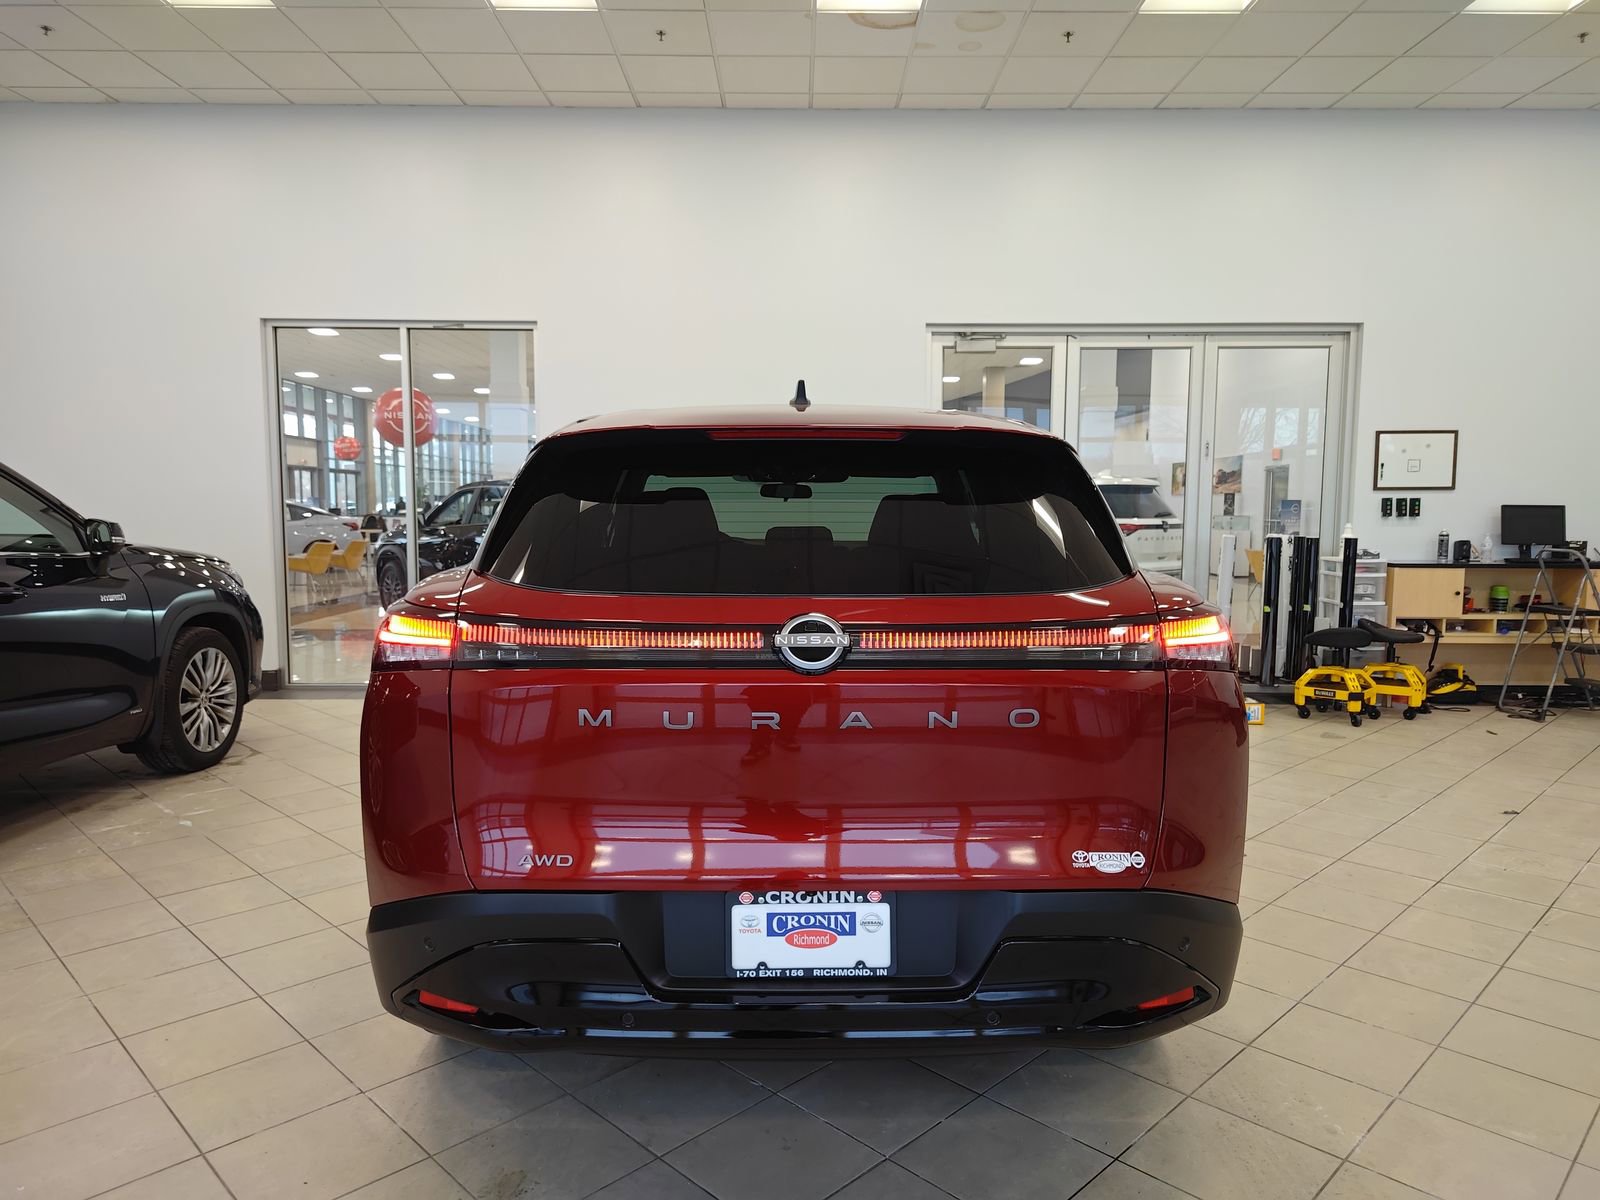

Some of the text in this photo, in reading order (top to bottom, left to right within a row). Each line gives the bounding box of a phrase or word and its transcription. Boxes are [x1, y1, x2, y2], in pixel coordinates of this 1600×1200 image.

[384, 411, 433, 420] NISAN
[776, 635, 849, 645] NISSAN
[577, 708, 1040, 730] MURANO
[518, 854, 574, 867] AWD
[1090, 853, 1129, 863] CRONIN
[765, 890, 855, 903] CRONIN
[772, 914, 851, 934] CRONIN
[793, 934, 830, 945] Richmond
[736, 968, 888, 978] I-70 EXIT 156 RICHMOND, IN
